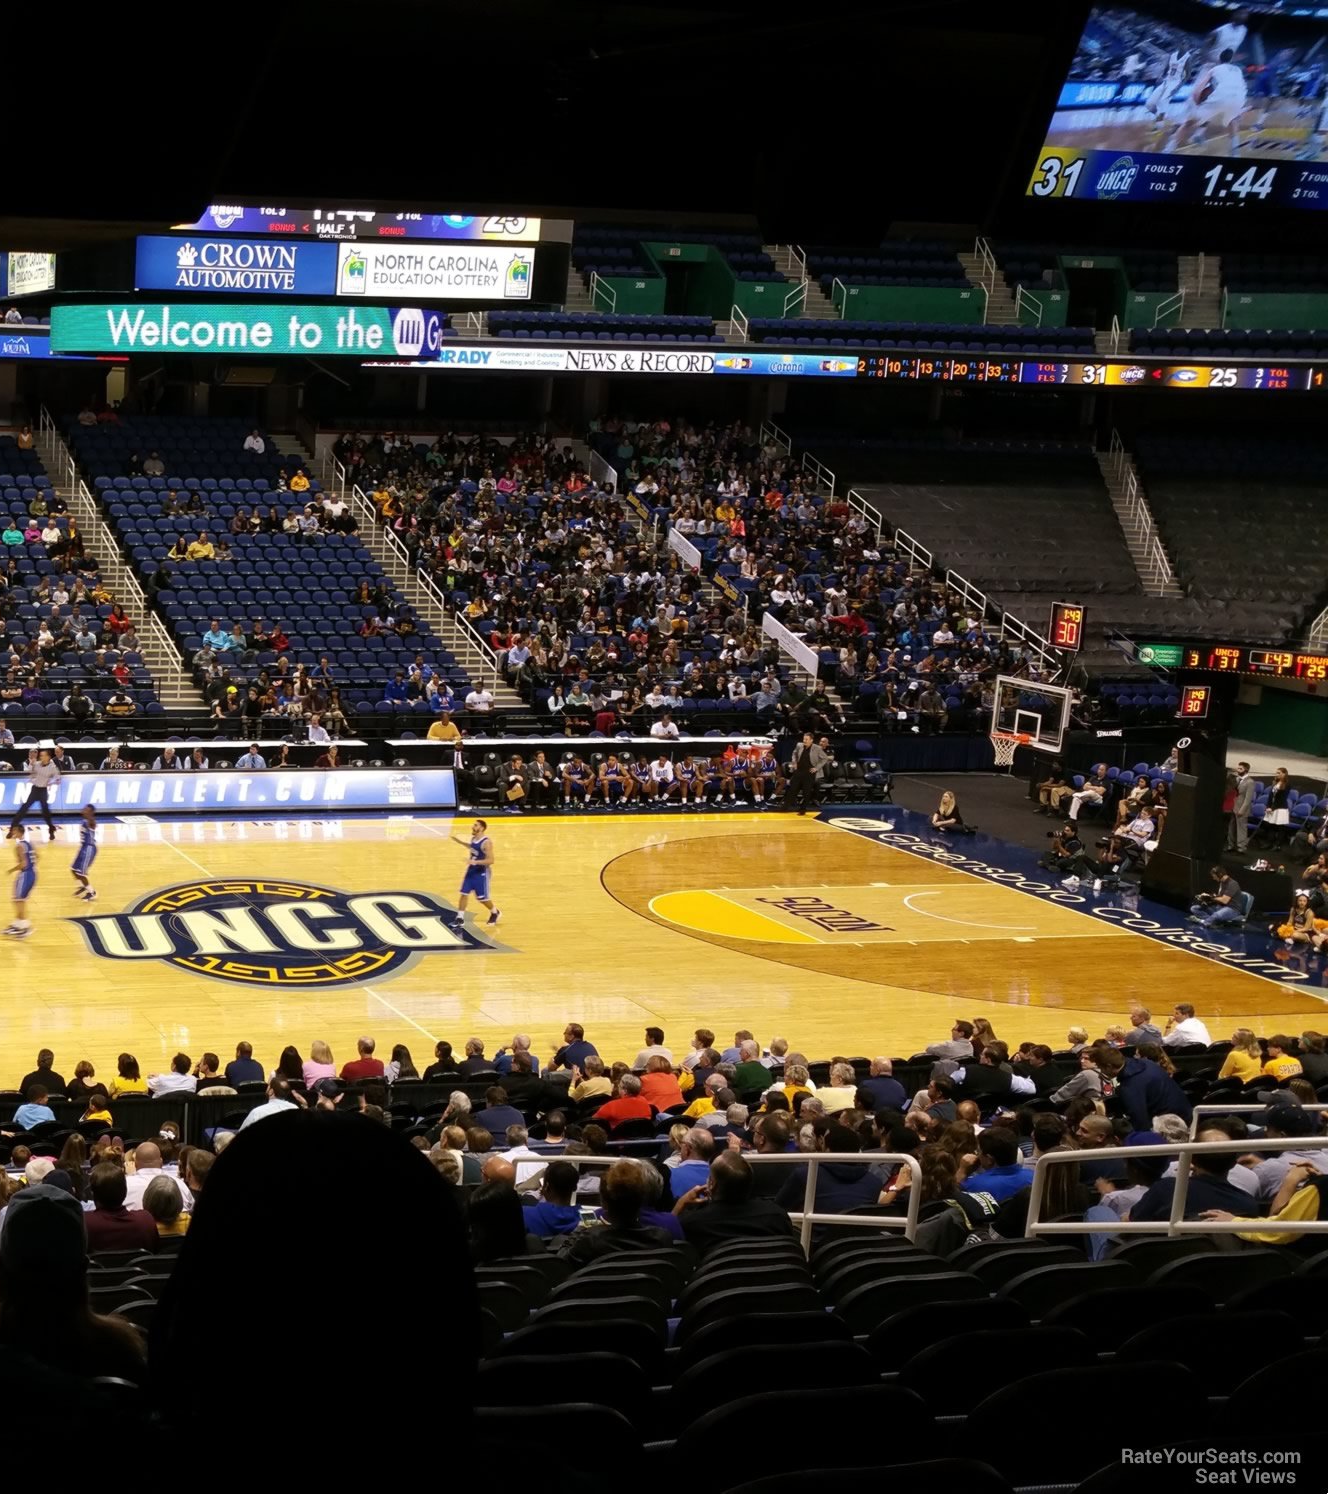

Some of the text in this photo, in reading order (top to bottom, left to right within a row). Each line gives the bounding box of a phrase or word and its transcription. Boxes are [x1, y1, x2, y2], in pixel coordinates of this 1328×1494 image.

[1144, 164, 1183, 176] FOULS 7
[1033, 157, 1086, 199] 31
[1096, 166, 1138, 191] UNCG
[1203, 164, 1278, 199] 1:44
[1300, 171, 1308, 182] 7
[1149, 182, 1177, 192] TOL 3
[1292, 188, 1320, 199] 3 TOL
[269, 223, 296, 232] BONUS
[316, 223, 356, 234] HALF 1
[379, 227, 406, 236] BONUS
[201, 244, 298, 270] CROWN
[374, 254, 499, 272] NORTH CAROLINA
[176, 269, 296, 291] AUTOMOTIVE
[373, 272, 499, 287] EDUCATION LOTTERY
[107, 310, 272, 350] Welcome
[288, 314, 323, 349] to
[335, 310, 384, 350] the
[564, 350, 714, 373] NEWS & RECORD
[769, 360, 803, 373] Corona
[858, 360, 865, 372] 2
[888, 361, 901, 373] 10
[1038, 363, 1069, 372] TOL 3
[920, 362, 933, 374] 13
[953, 363, 968, 375] 20
[987, 365, 1001, 377] 33
[1256, 368, 1289, 378] 3 TOL
[1037, 374, 1067, 382] FLS 7
[1082, 365, 1106, 384] 31
[1209, 368, 1238, 387] 25
[1315, 372, 1323, 385] 1
[1254, 378, 1287, 388] 7 FLS
[1063, 610, 1081, 622] 1:43
[1058, 622, 1077, 644] 30
[1215, 648, 1239, 658] UNCG
[1190, 654, 1199, 666] 3
[1220, 656, 1238, 668] 31
[1264, 653, 1292, 667] 1:43
[1307, 665, 1326, 678] 25
[1191, 690, 1205, 700] 1:43
[1187, 701, 1201, 712] 30
[879, 832, 1309, 982] Greensboro Coliseum
[755, 896, 897, 932] SOCON
[80, 893, 475, 958] UNCG
